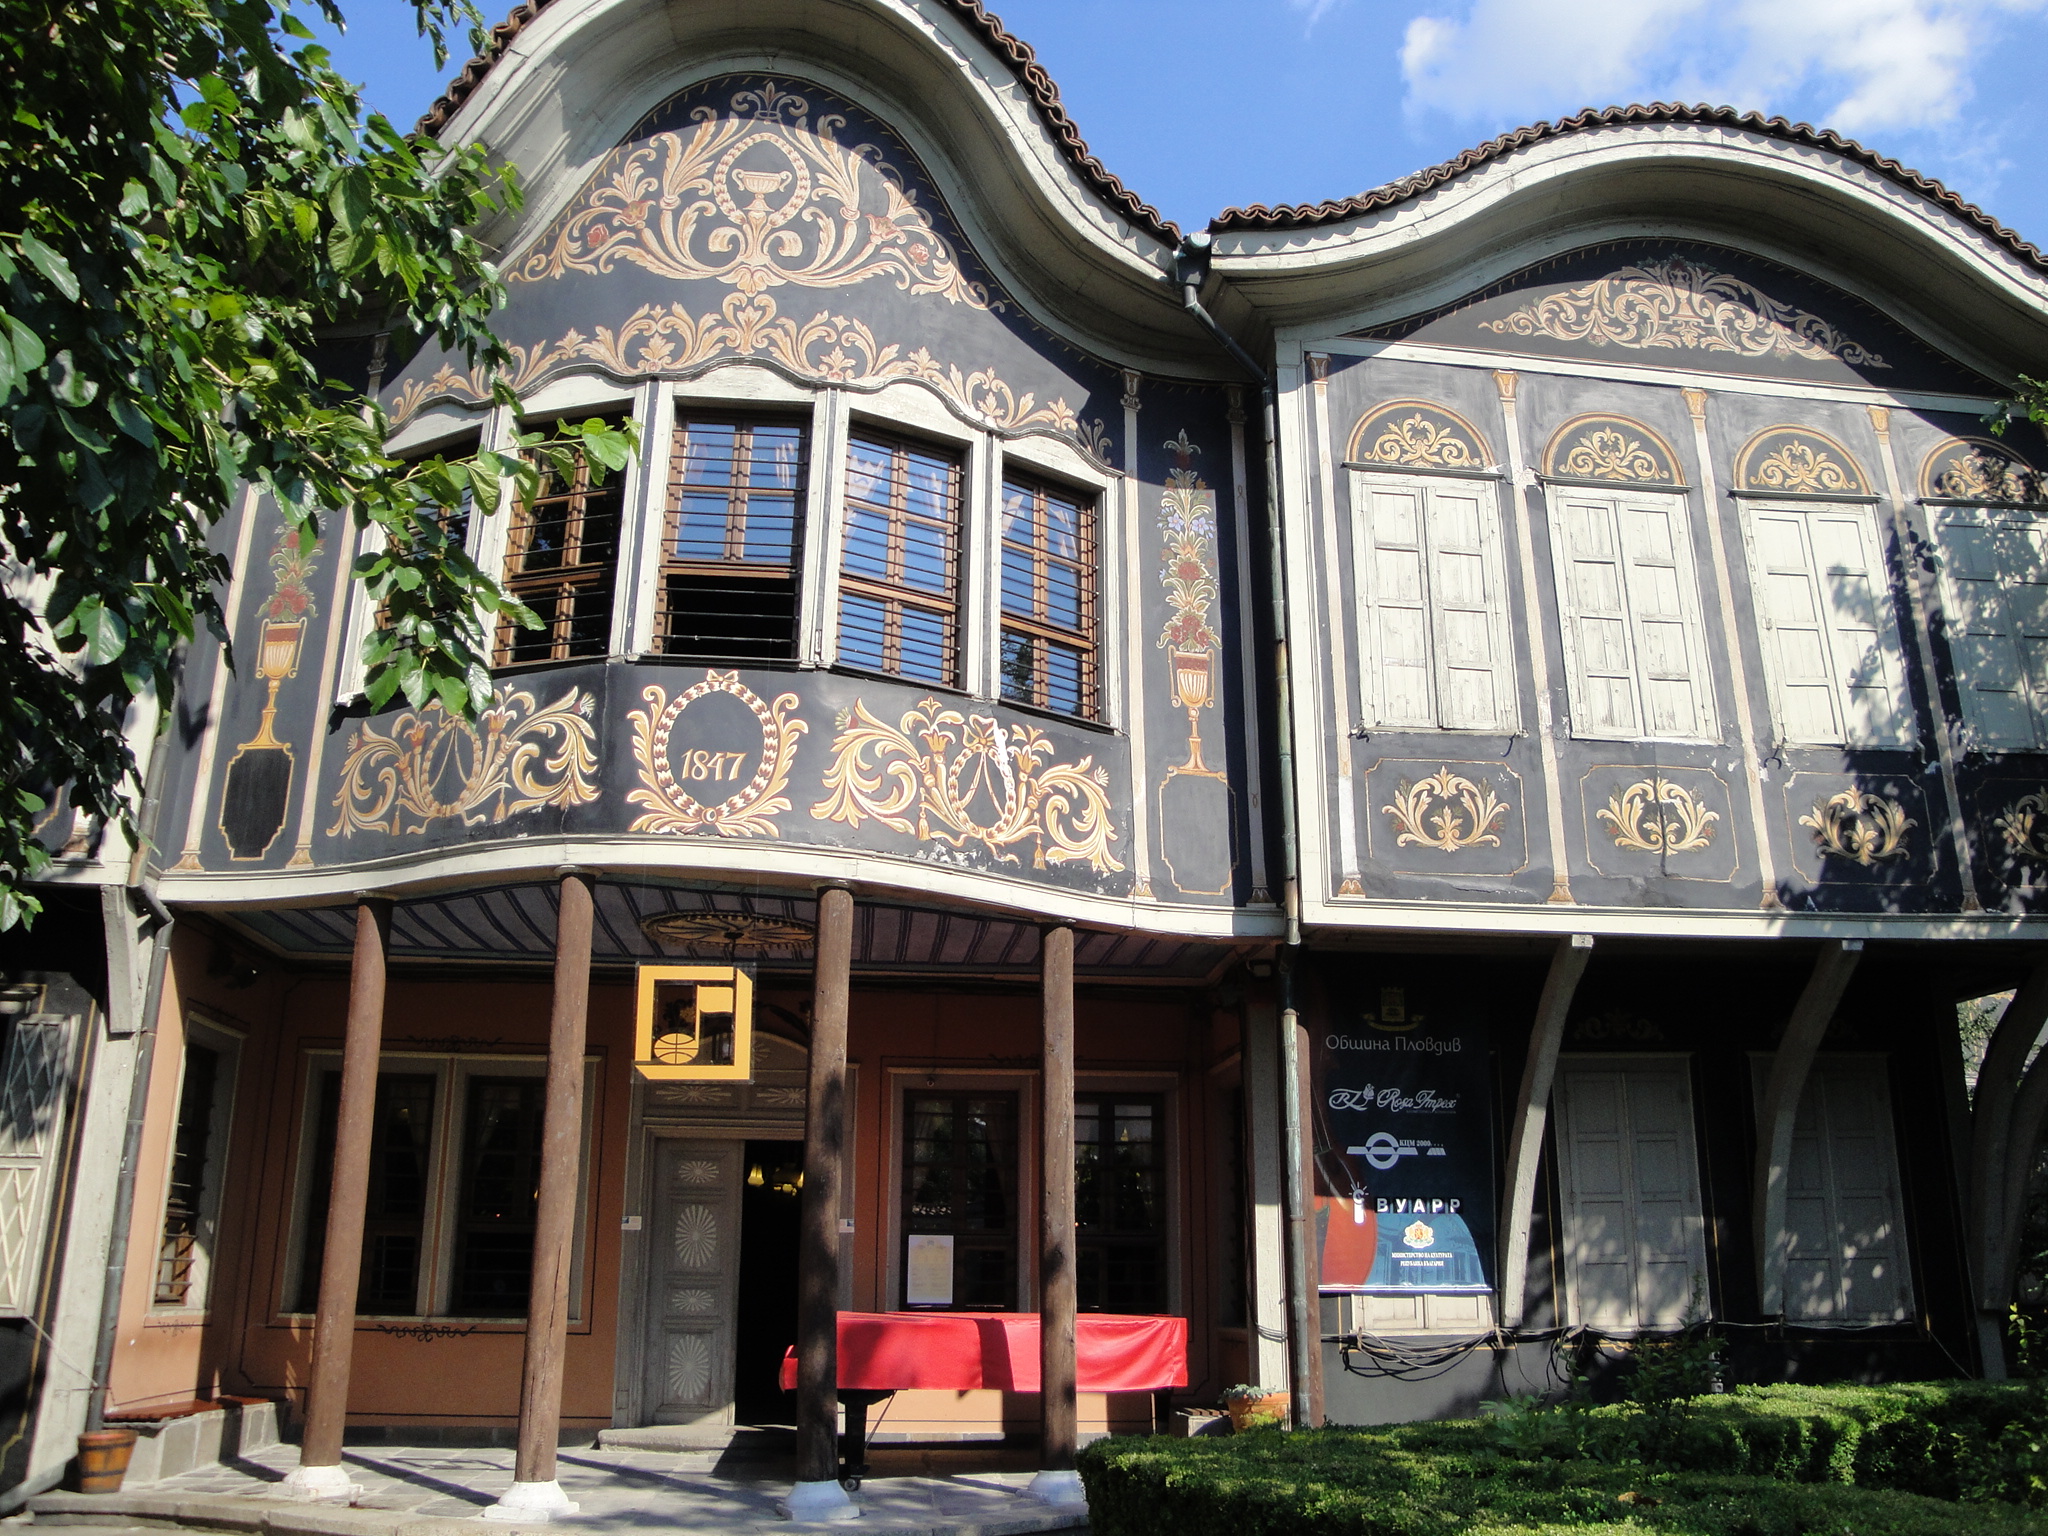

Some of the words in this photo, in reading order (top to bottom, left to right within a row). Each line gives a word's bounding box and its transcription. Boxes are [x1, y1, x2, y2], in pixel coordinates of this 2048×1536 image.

[681, 748, 747, 781] 1847
[1325, 1034, 1391, 1051] Община
[1395, 1036, 1462, 1055] Пловдив
[1376, 1087, 1413, 1112] Rosa
